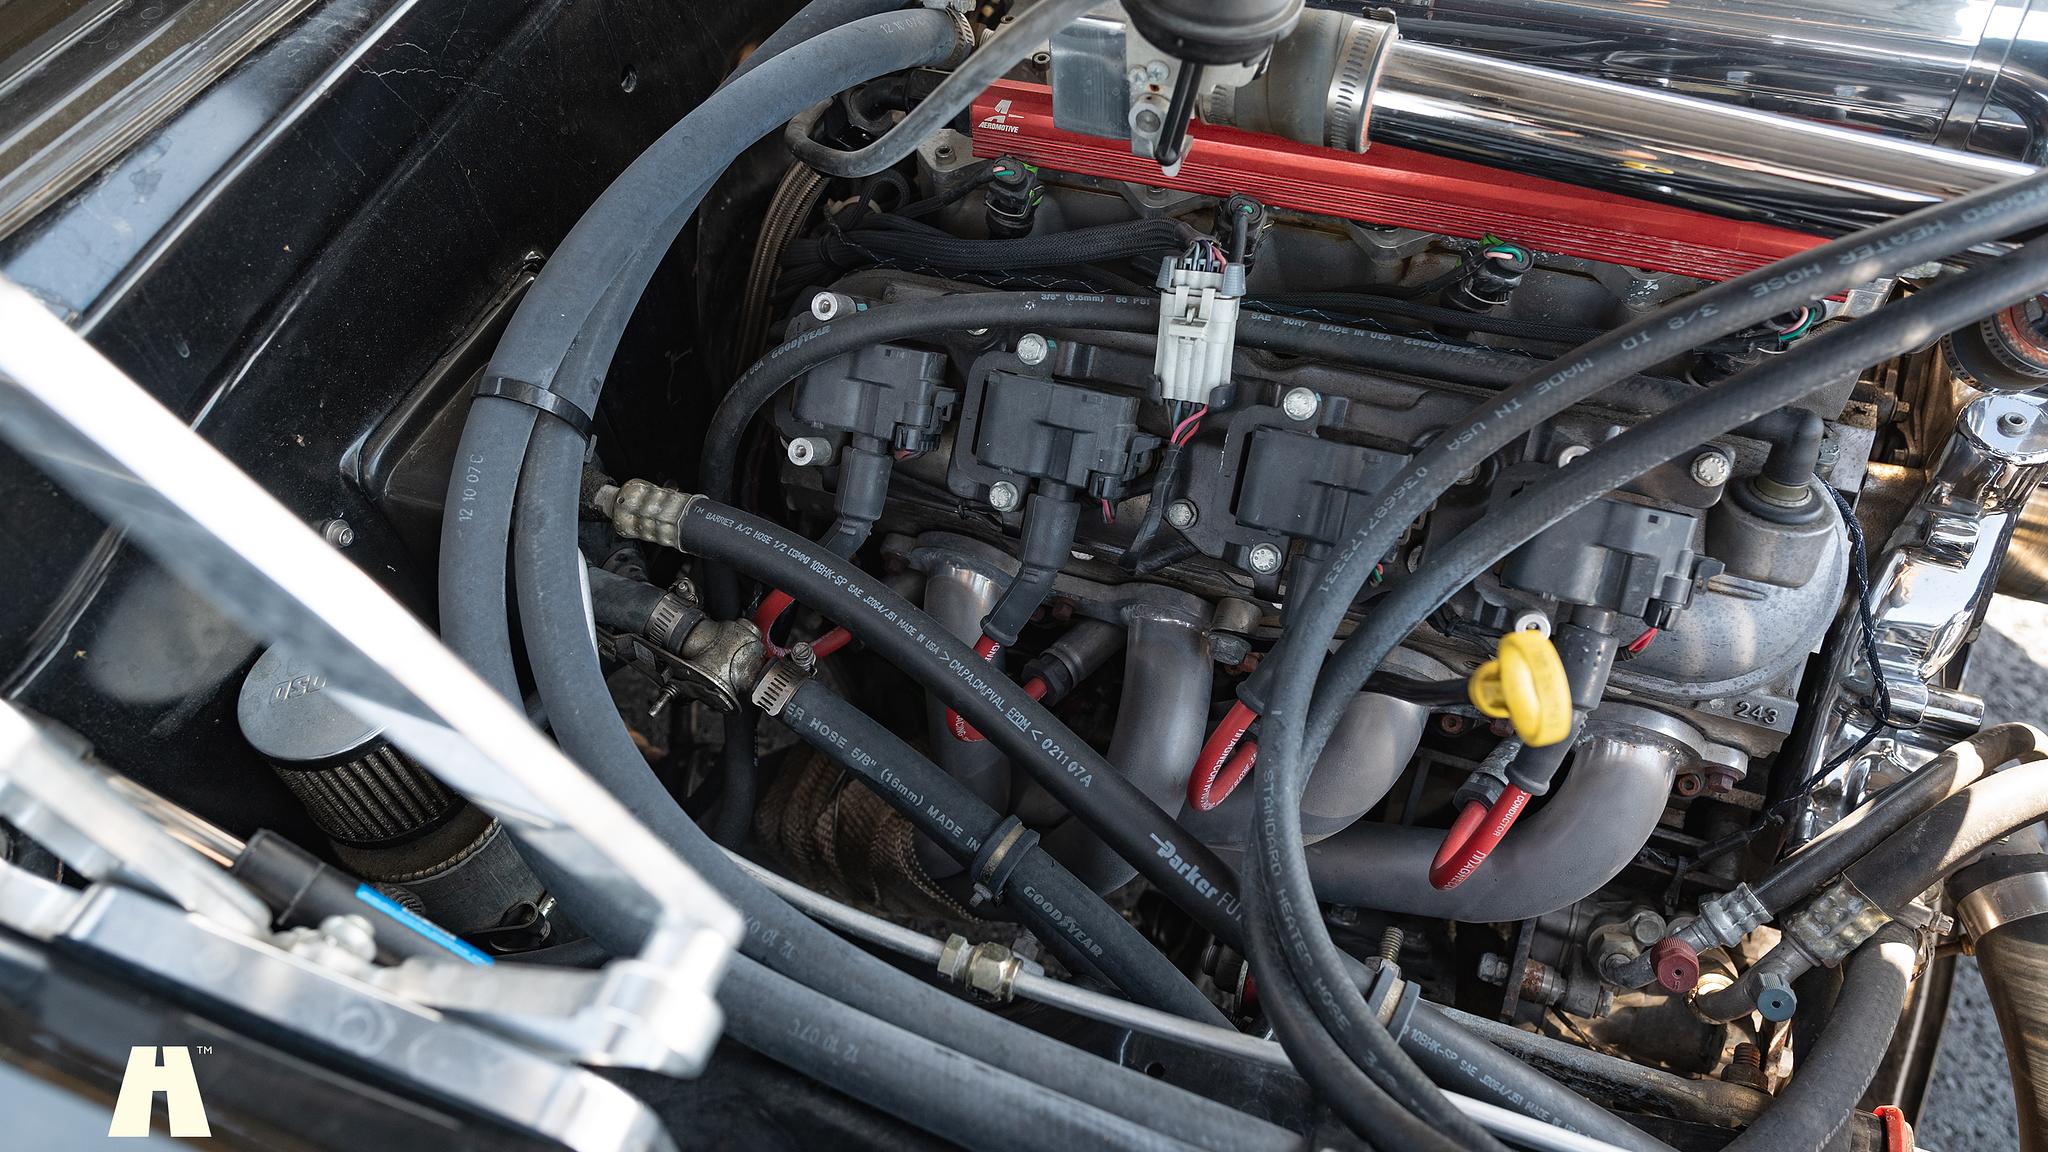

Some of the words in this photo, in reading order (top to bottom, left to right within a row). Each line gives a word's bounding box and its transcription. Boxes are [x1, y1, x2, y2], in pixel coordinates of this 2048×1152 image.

[978, 122, 1019, 134] AEROMOTIVE
[1838, 220, 1946, 265] HEATER
[1751, 262, 1823, 298] HOSE
[1133, 298, 1150, 306] PSI
[1251, 312, 1272, 323] SAE
[1318, 323, 1349, 336] MADE
[1353, 328, 1365, 337] IN
[1370, 330, 1393, 342] USA
[1667, 303, 1719, 330] 3/8
[749, 360, 765, 375] USA
[771, 324, 832, 359] GOODYEAR
[1620, 331, 1650, 351] ID
[1534, 357, 1594, 395] MADE
[1494, 398, 1522, 419] IN
[1446, 422, 1487, 450] USA
[459, 508, 473, 522] 12
[462, 488, 477, 502] 10
[705, 511, 735, 528] BARRIER
[735, 523, 753, 537] A/C
[753, 530, 772, 545] HOSE
[773, 540, 788, 552] 1/2
[810, 560, 848, 587] 10BHK-SP
[847, 583, 864, 598] SAE
[863, 596, 898, 622] J2064/J51
[897, 619, 917, 637] MADE
[916, 633, 926, 644] IN
[925, 640, 940, 655] USA
[1005, 706, 1031, 733] EPDM
[1733, 700, 1779, 725] 243
[809, 717, 848, 749] HOSE
[851, 747, 878, 767] 5/8"
[880, 768, 924, 806] (16mm)
[927, 805, 963, 837] MADE
[1493, 795, 1525, 837] CONDUCTOR
[1149, 832, 1219, 899] Parker
[1263, 769, 1282, 876] STANDARD
[1277, 888, 1313, 970] HEATER
[1312, 977, 1350, 1032] HOSE
[1023, 886, 1103, 958] GOODYEAR
[1410, 1028, 1458, 1061] 10BHK-SP
[1459, 1060, 1478, 1077] SAE
[1524, 1100, 1550, 1122] MADE
